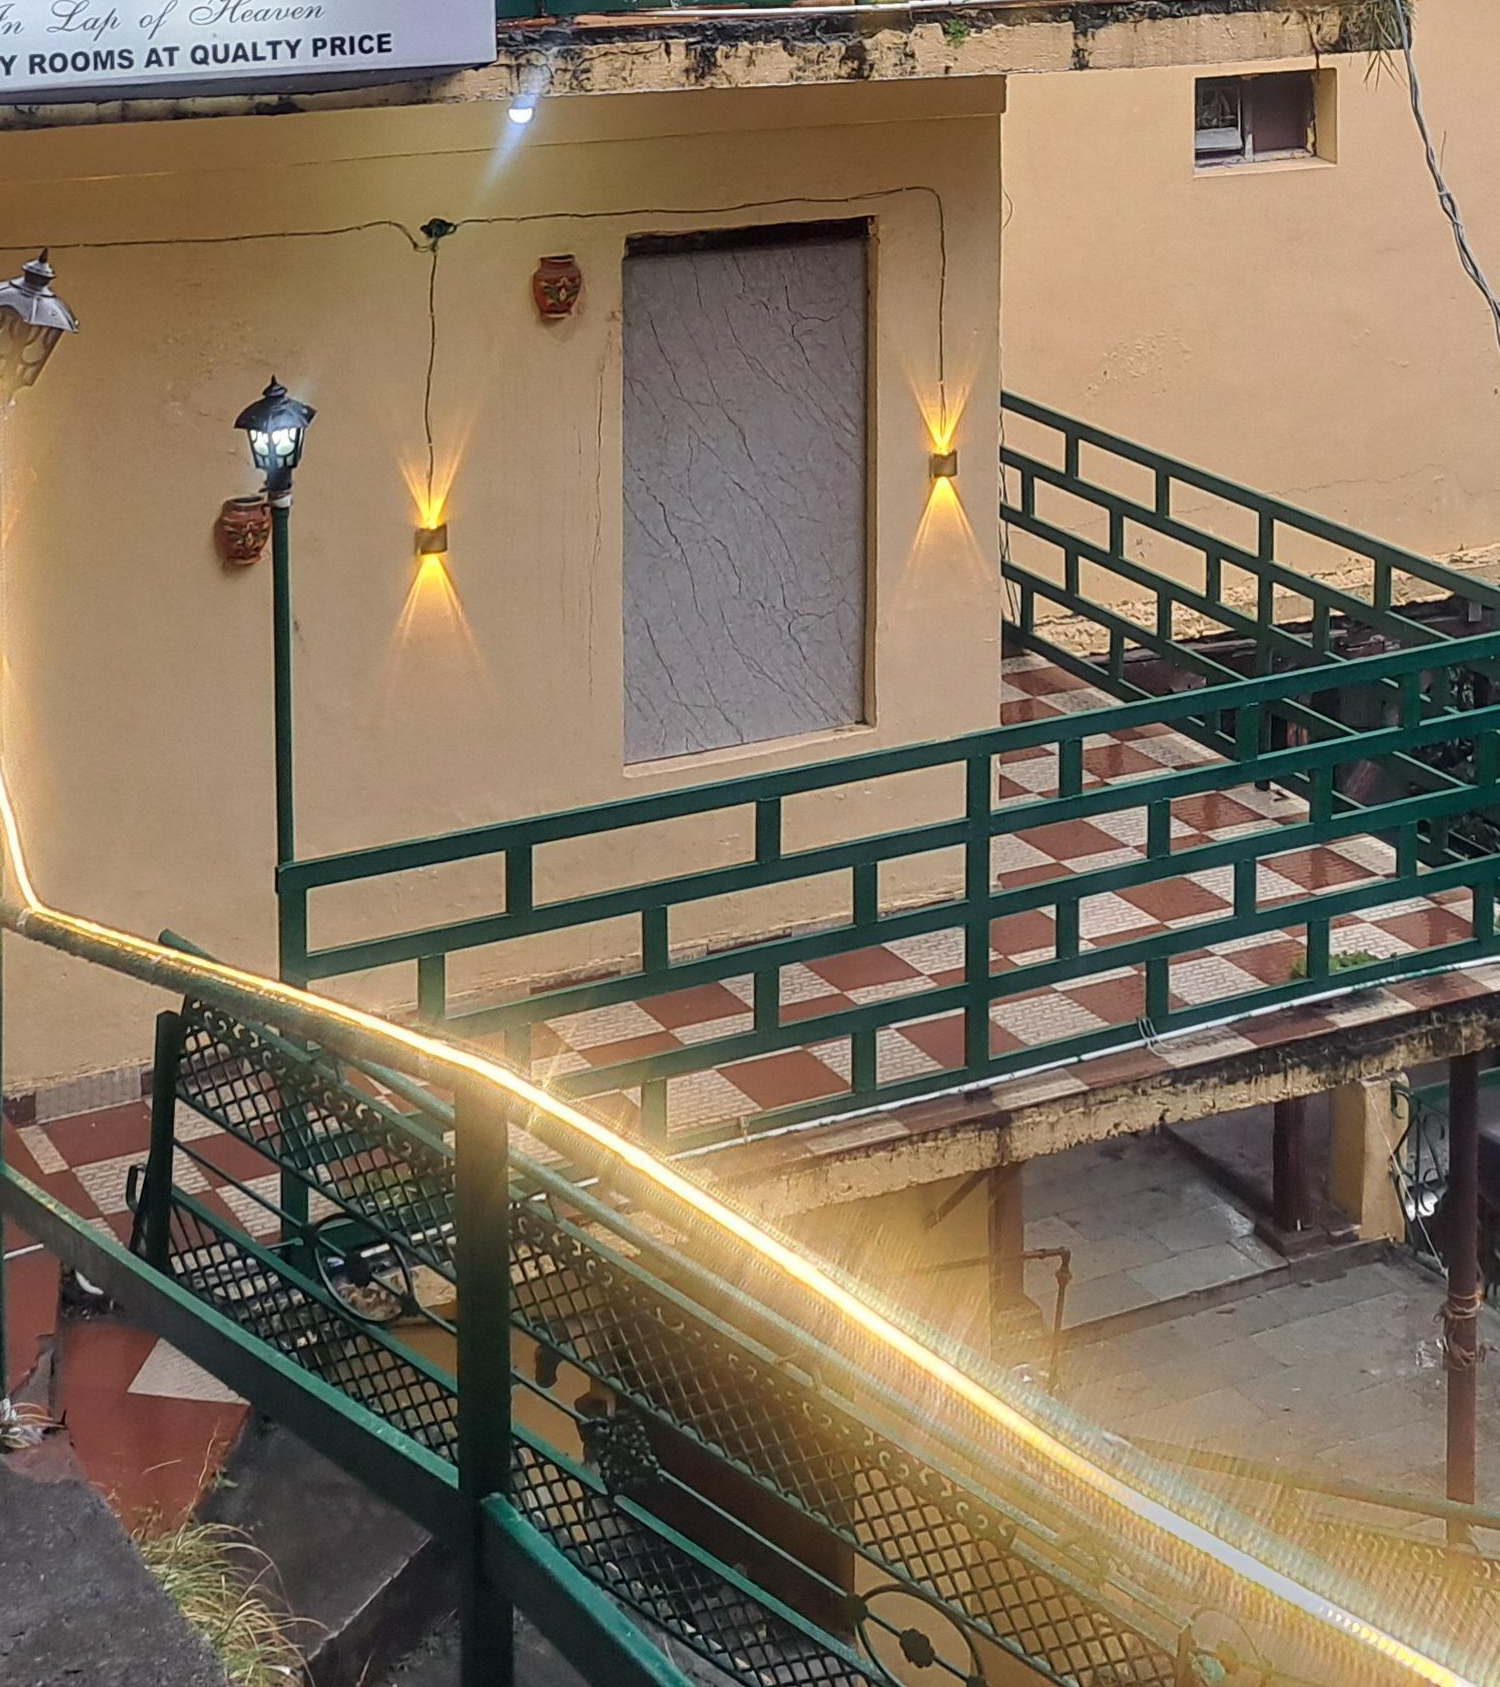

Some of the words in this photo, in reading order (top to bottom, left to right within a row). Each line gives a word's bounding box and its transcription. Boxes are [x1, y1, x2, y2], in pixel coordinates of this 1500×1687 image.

[46, 0, 121, 42] Lap
[139, 0, 178, 40] of
[28, 48, 135, 75] ROOMS
[144, 46, 180, 68] AT
[190, 38, 303, 66] QUALTY
[312, 32, 393, 58] PRICE
